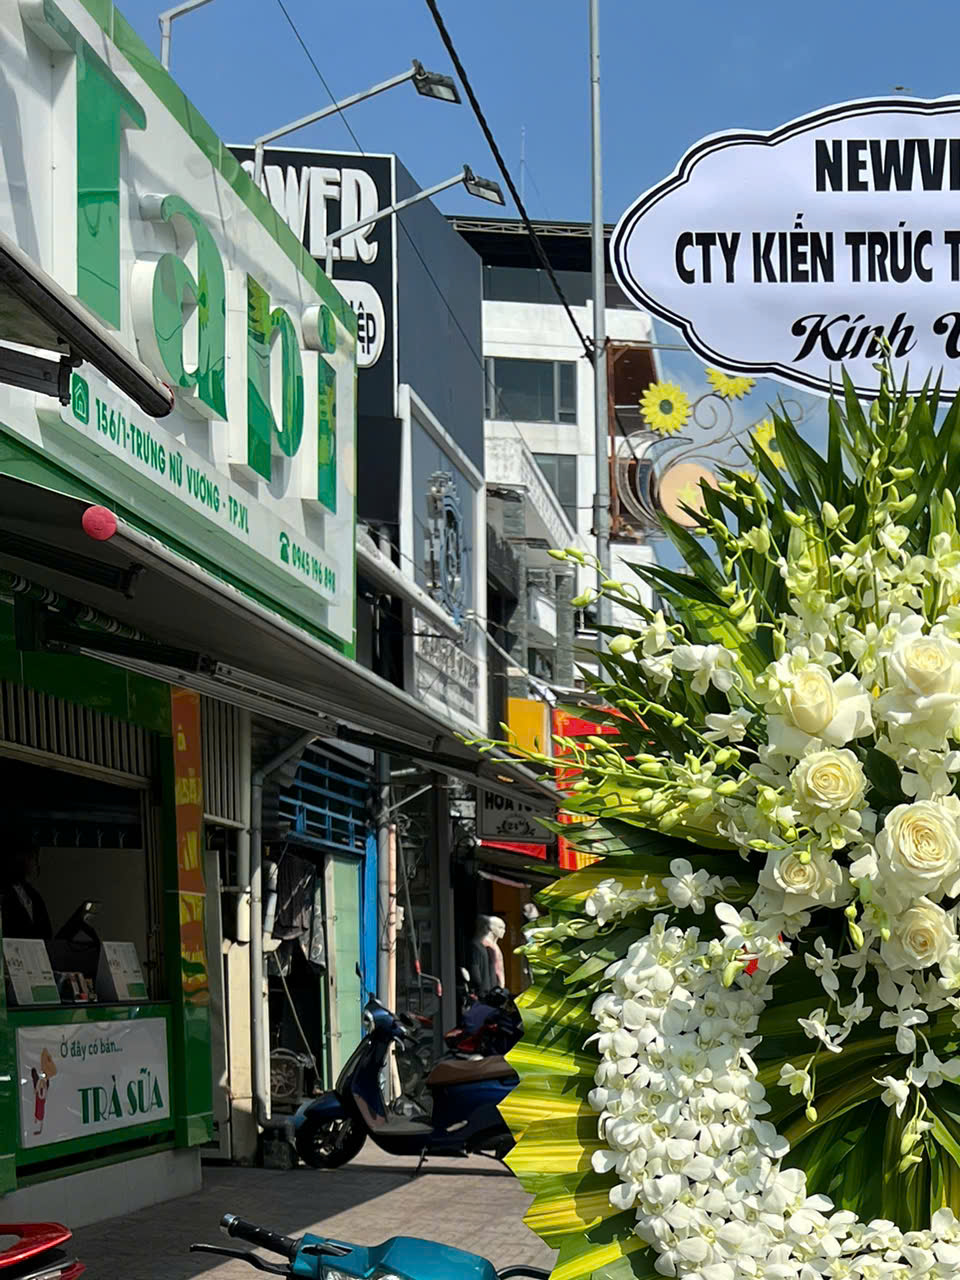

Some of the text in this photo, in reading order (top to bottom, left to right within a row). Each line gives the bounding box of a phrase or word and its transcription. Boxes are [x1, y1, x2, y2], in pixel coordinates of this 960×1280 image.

[675, 231, 741, 285] CTY
[752, 213, 833, 284] KIẾN
[844, 221, 933, 284] TRÚC
[791, 312, 918, 363] Kính
[70, 1041, 87, 1061] đây
[88, 1037, 99, 1055] có
[78, 1067, 164, 1124] TRÀ SỮA
